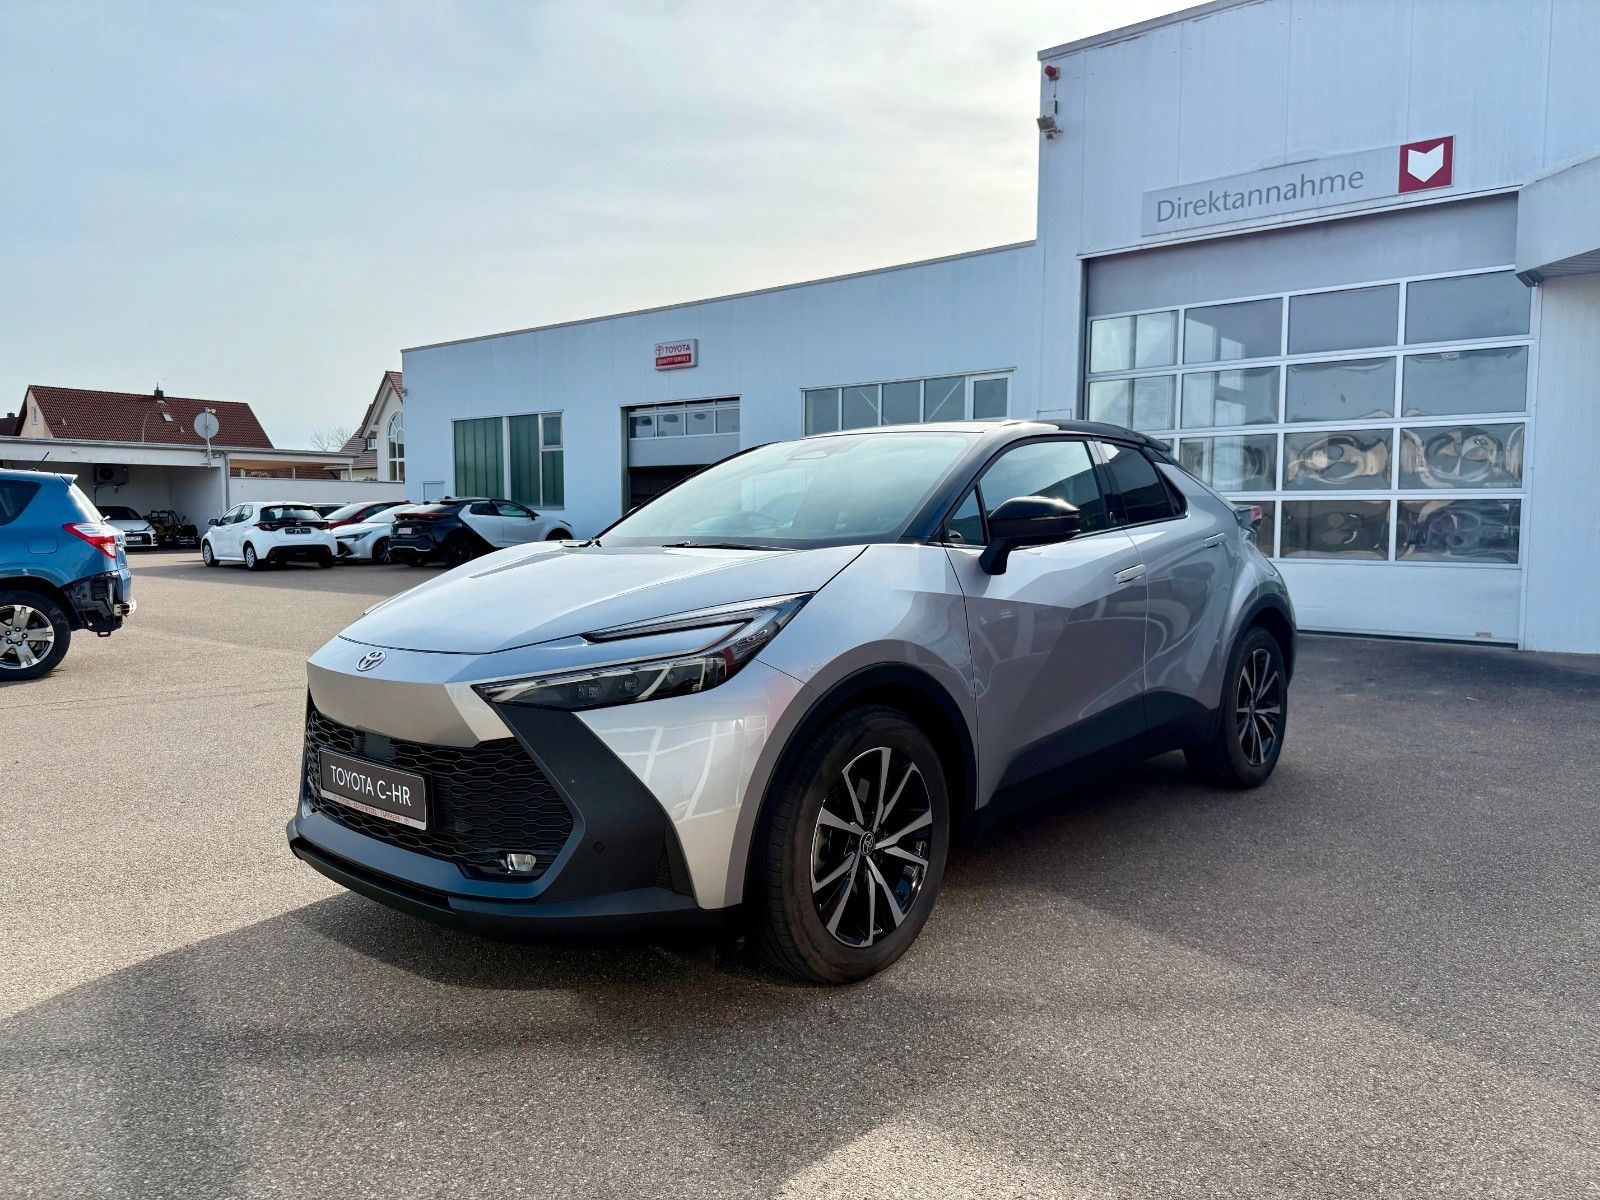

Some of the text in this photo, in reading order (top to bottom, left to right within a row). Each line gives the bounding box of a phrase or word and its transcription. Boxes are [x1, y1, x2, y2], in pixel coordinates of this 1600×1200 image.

[1157, 170, 1364, 223] Direktannahme
[665, 344, 691, 354] TOYOTA
[330, 765, 375, 796] TOYOTA
[377, 780, 411, 807] C-HR
